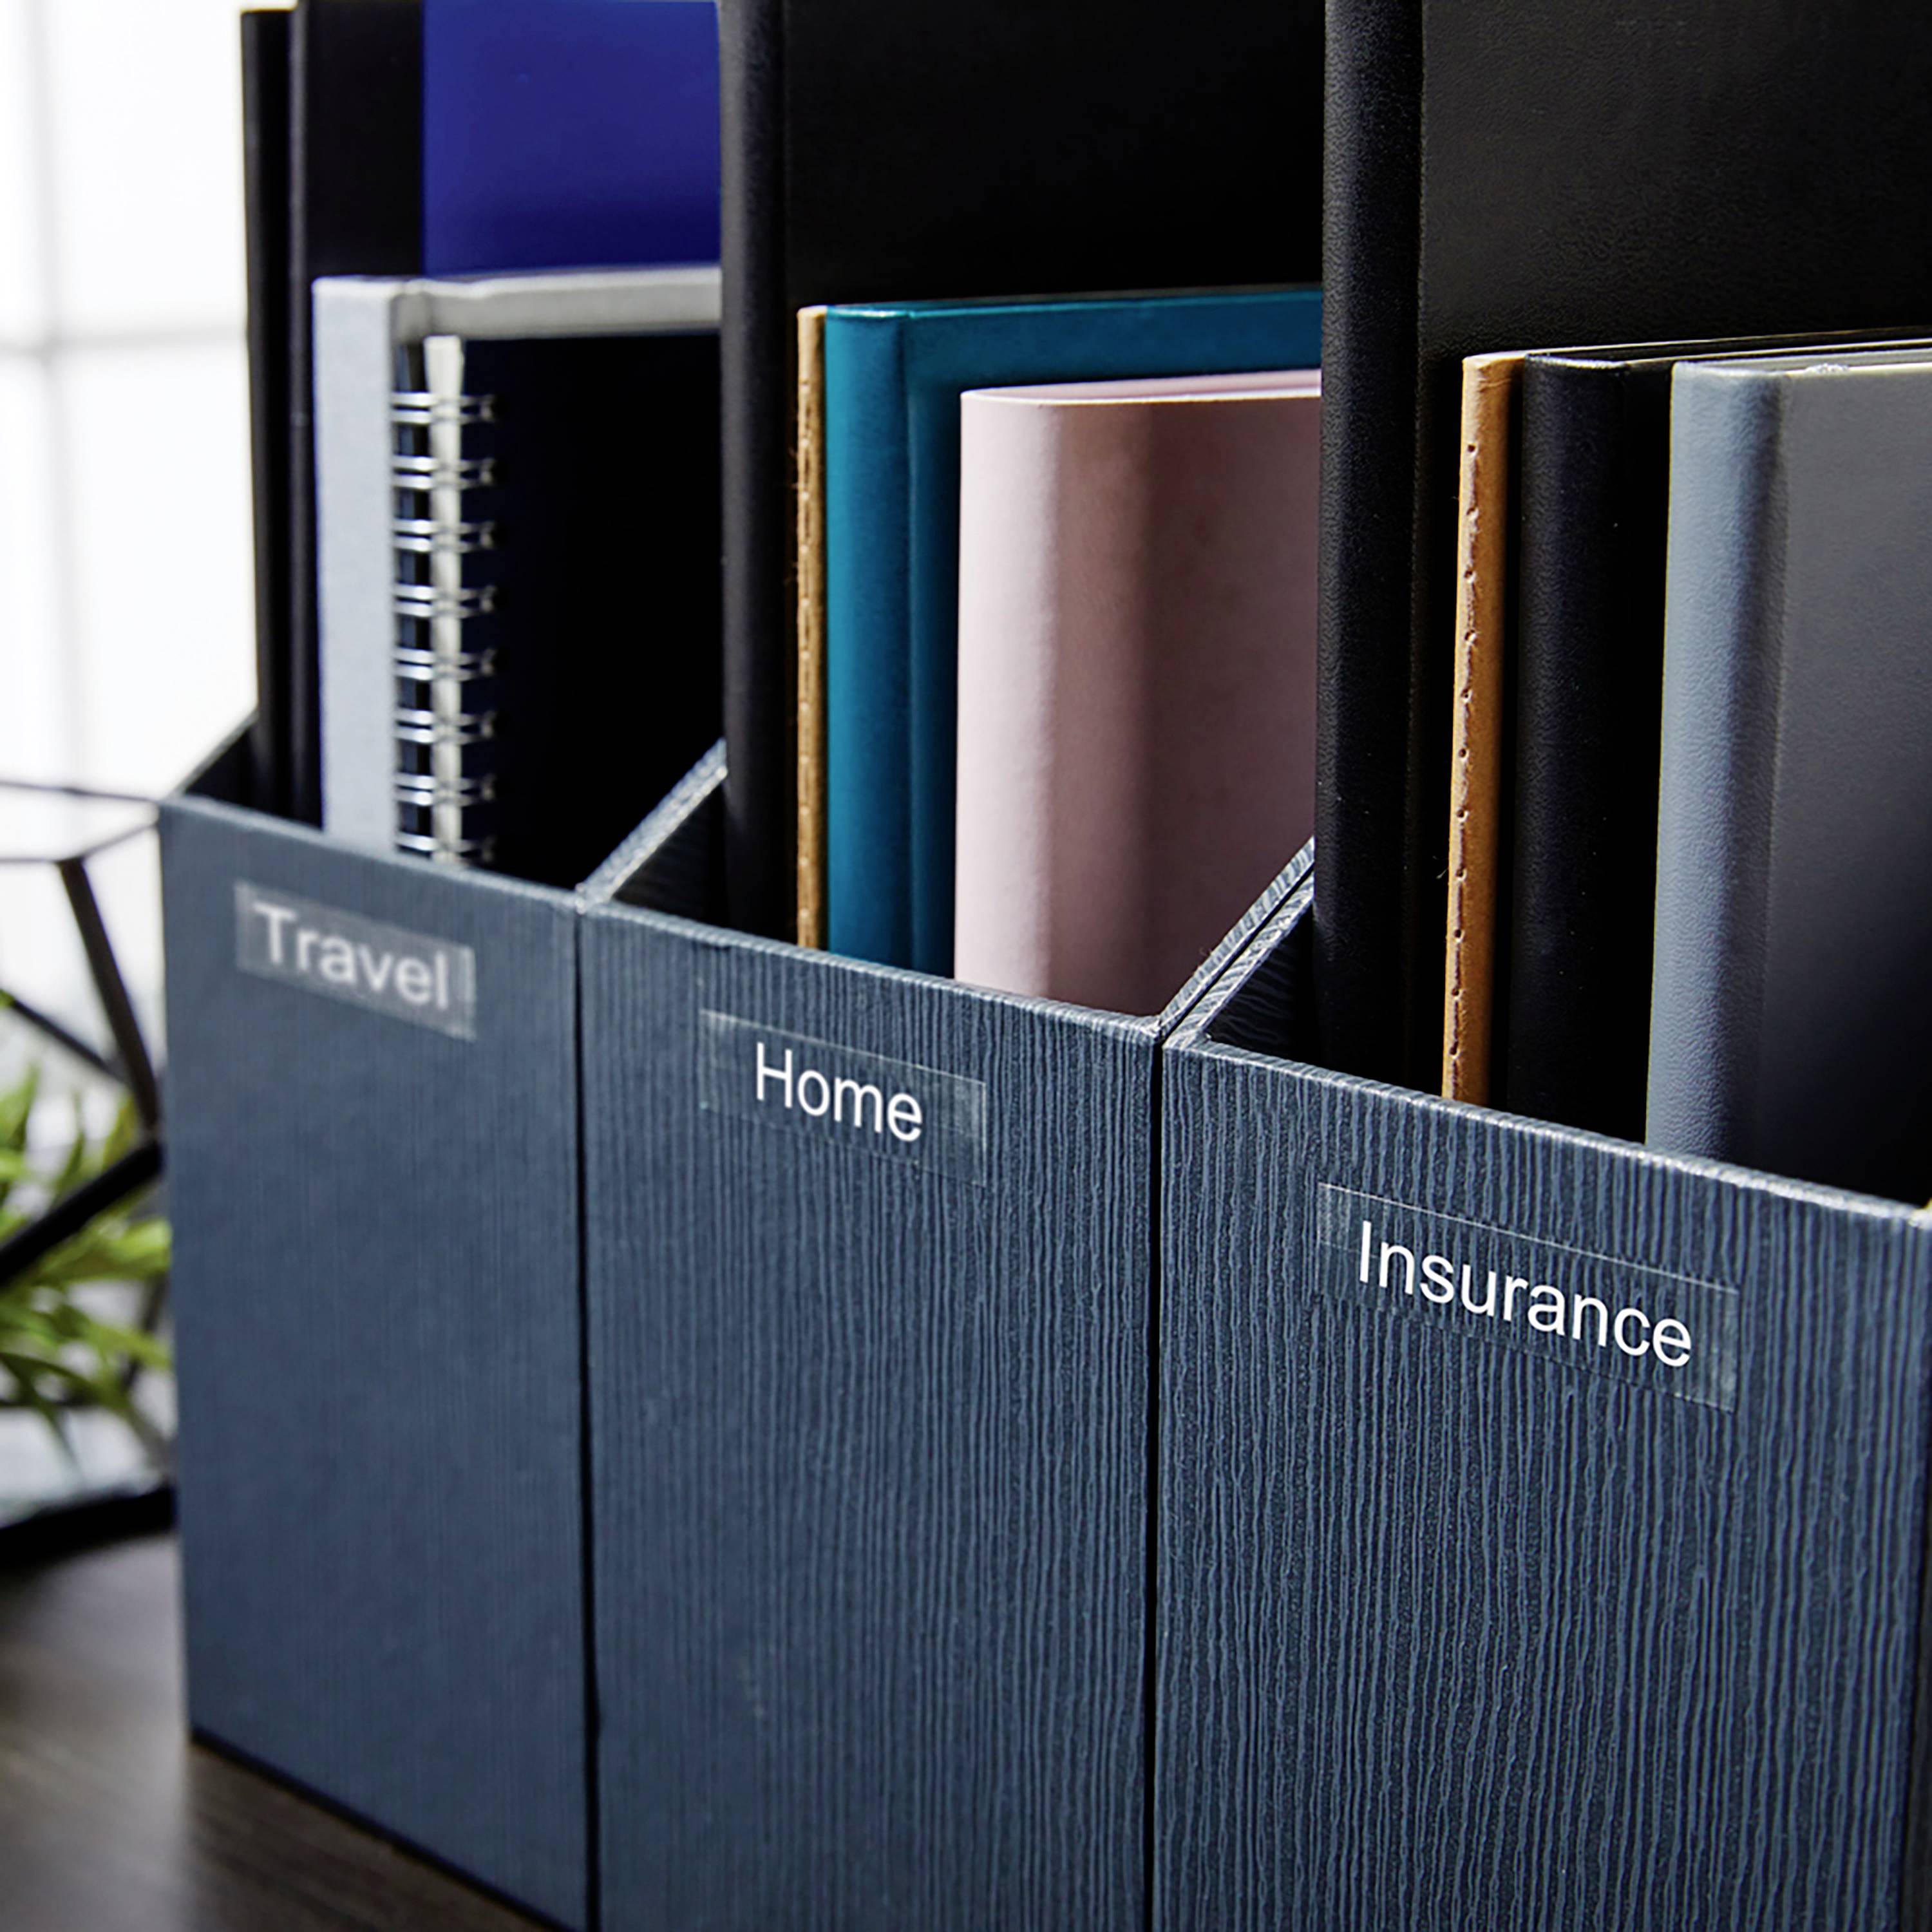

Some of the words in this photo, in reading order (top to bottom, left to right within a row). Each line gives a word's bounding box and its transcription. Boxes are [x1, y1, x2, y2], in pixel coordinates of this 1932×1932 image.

[254, 903, 449, 1009] Travel
[756, 1041, 922, 1142] Home
[1359, 1220, 1692, 1367] Insurance
